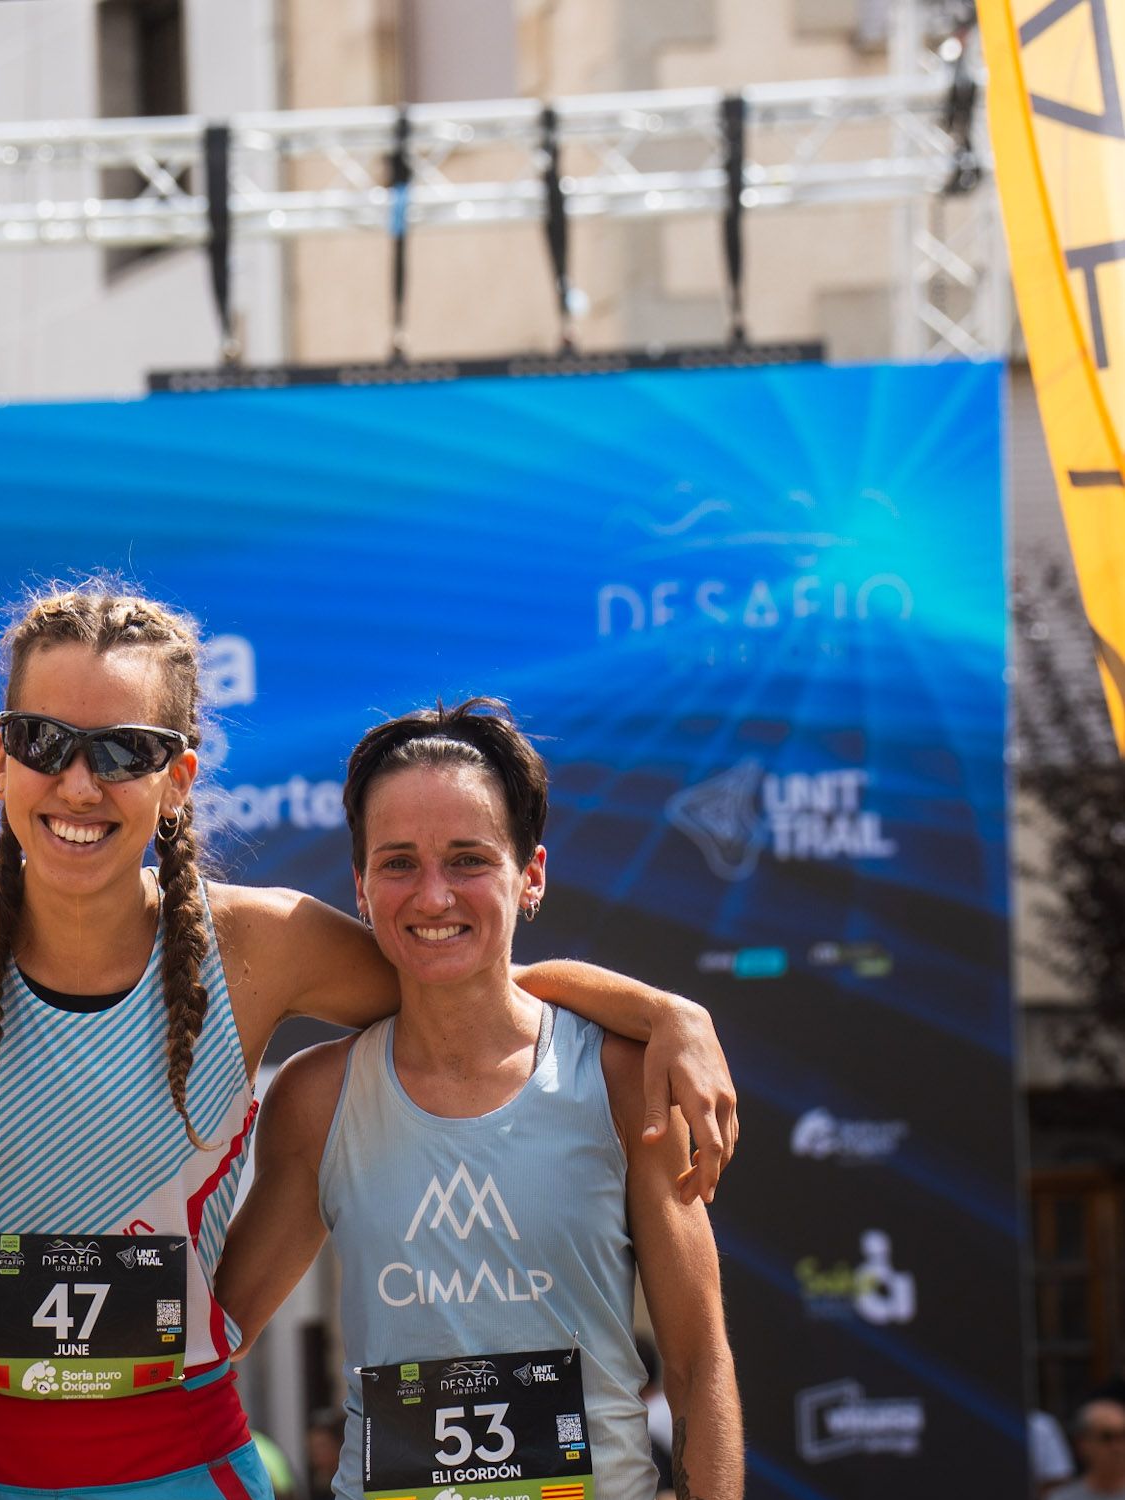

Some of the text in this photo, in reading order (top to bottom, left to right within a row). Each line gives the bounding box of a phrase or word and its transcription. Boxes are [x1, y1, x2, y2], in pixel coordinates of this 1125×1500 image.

[42, 1252, 102, 1266] DESAFÍO
[136, 1248, 157, 1258] UNIT
[55, 1264, 90, 1272] URBIÓN
[137, 1258, 163, 1267] TRAIL
[378, 1259, 553, 1307] CIMALP
[32, 1283, 111, 1340] 47
[54, 1344, 90, 1356] JUNE
[62, 1369, 122, 1383] Soria puro
[533, 1365, 552, 1374] UNIT
[441, 1373, 499, 1391] DESAFÍO
[533, 1373, 559, 1382] TRAIL
[61, 1381, 111, 1394] Oxígeno
[434, 1402, 516, 1467] 53
[432, 1462, 521, 1484] ELI GORDÓN
